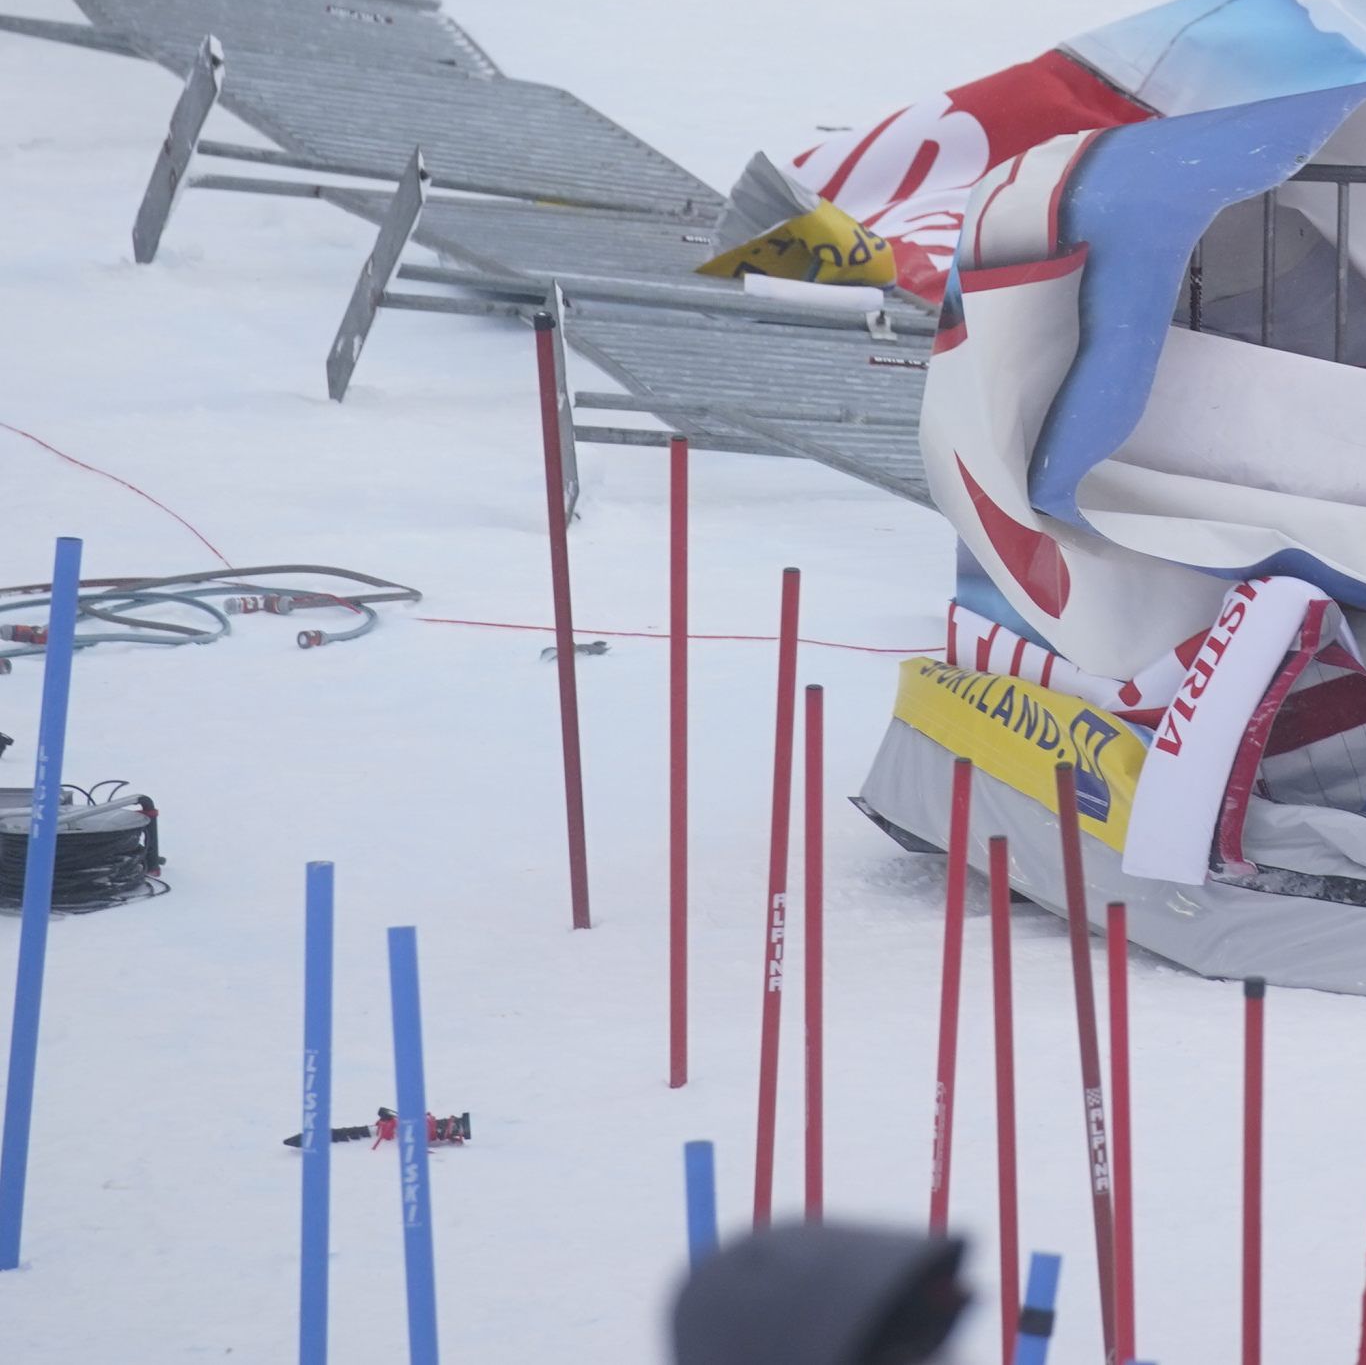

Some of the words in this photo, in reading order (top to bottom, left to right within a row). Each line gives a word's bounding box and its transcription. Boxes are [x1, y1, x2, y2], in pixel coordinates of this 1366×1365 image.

[303, 1054, 318, 1149] LISKI
[1088, 1107, 1109, 1191] ALPINA
[403, 1124, 421, 1223] LISKI
